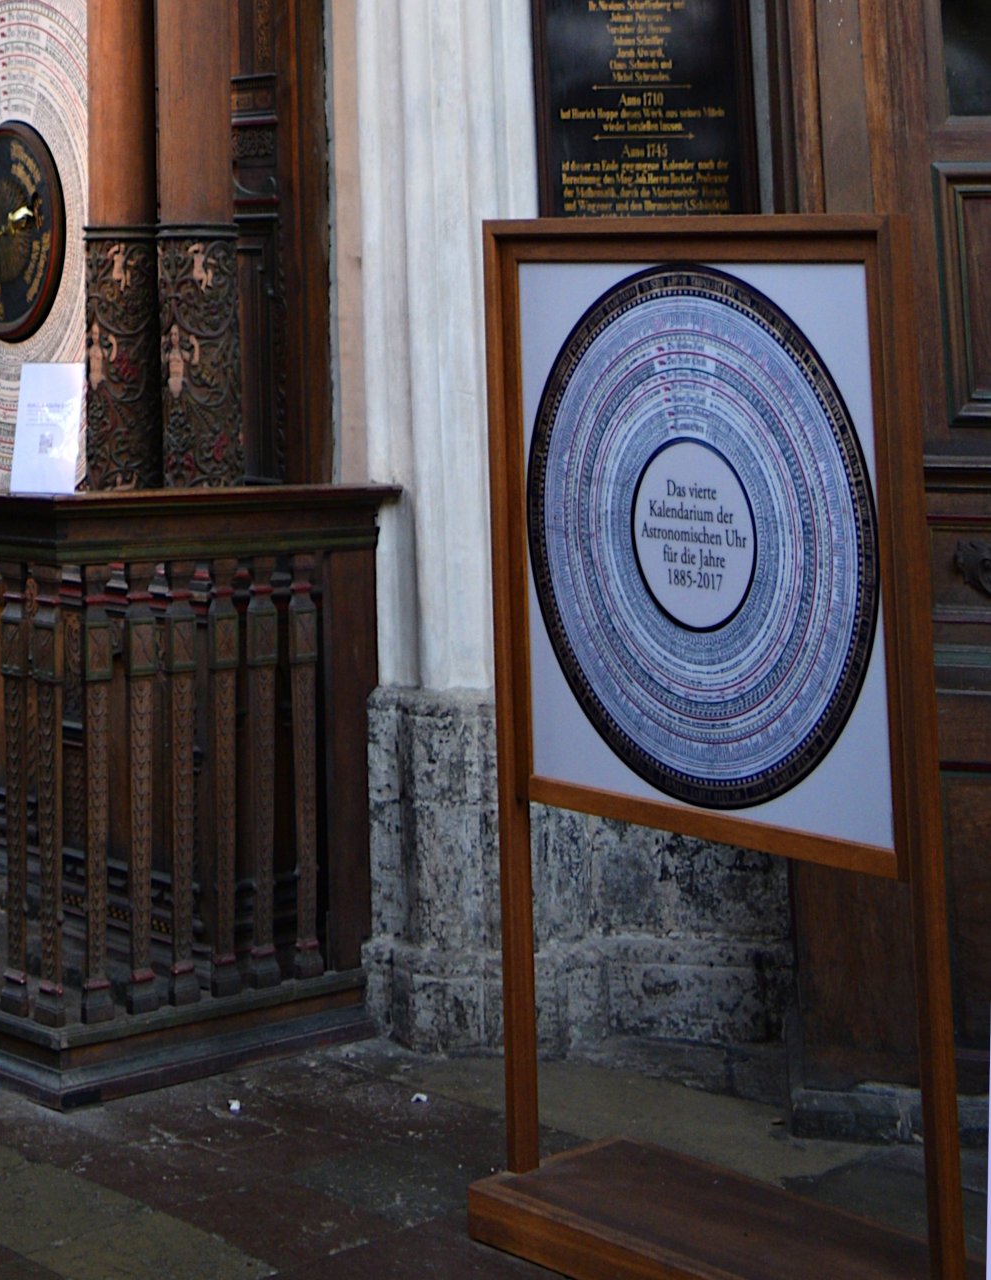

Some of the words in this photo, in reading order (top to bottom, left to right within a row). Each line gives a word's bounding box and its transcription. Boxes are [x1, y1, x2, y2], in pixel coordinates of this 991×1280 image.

[619, 93, 642, 107] Anno
[642, 91, 664, 106] 1710
[622, 144, 644, 158] Anno
[646, 142, 668, 158] 1745
[666, 480, 686, 497] Das
[689, 482, 717, 500] vierte
[649, 500, 714, 522] Kalendarium
[716, 506, 734, 524] der
[642, 522, 722, 546] Astronomischen
[726, 529, 746, 548] Uhr
[663, 544, 678, 563] für
[680, 546, 696, 565] die
[699, 549, 726, 570] Jahre
[668, 568, 723, 592] 1885-2017
